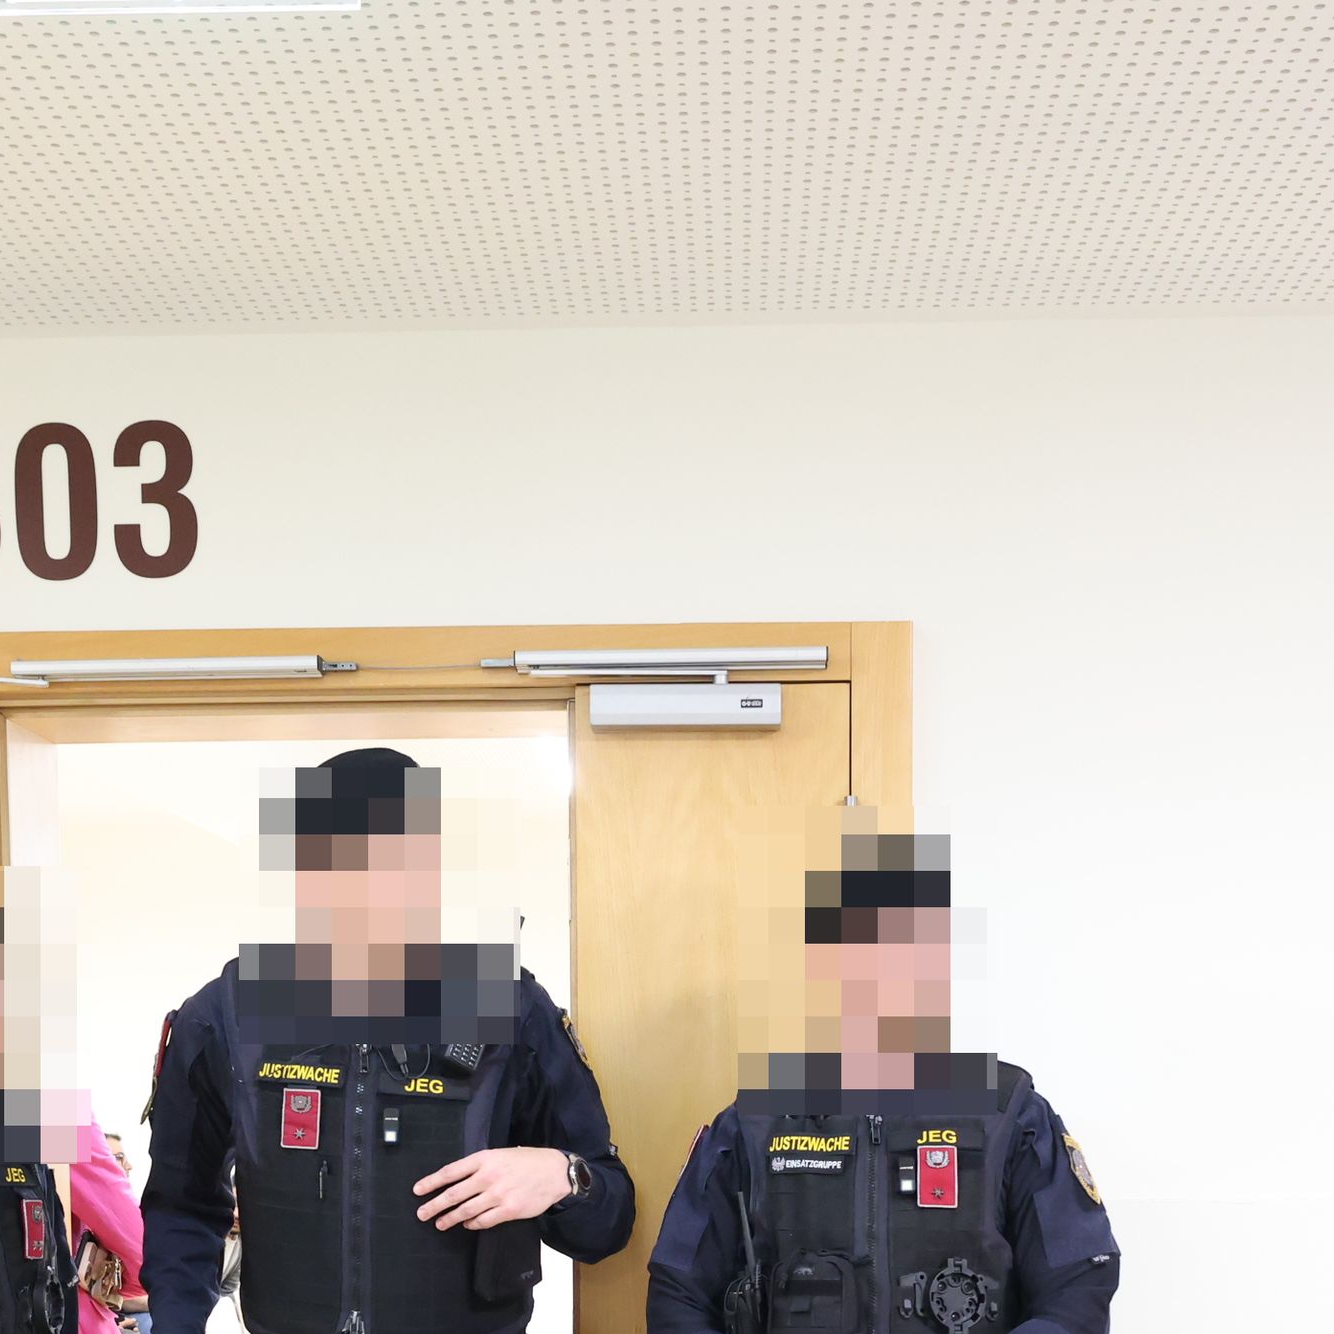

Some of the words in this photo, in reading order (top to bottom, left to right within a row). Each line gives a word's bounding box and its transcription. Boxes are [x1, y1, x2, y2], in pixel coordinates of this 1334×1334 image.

[258, 1062, 341, 1084] JUSTIZWACHE
[404, 1078, 444, 1094] JEG
[769, 1135, 851, 1152] JUSTIZWACHE
[917, 1129, 957, 1144] JEG
[785, 1159, 842, 1169] EINSATZGRUPPE
[5, 1167, 27, 1183] JEG
